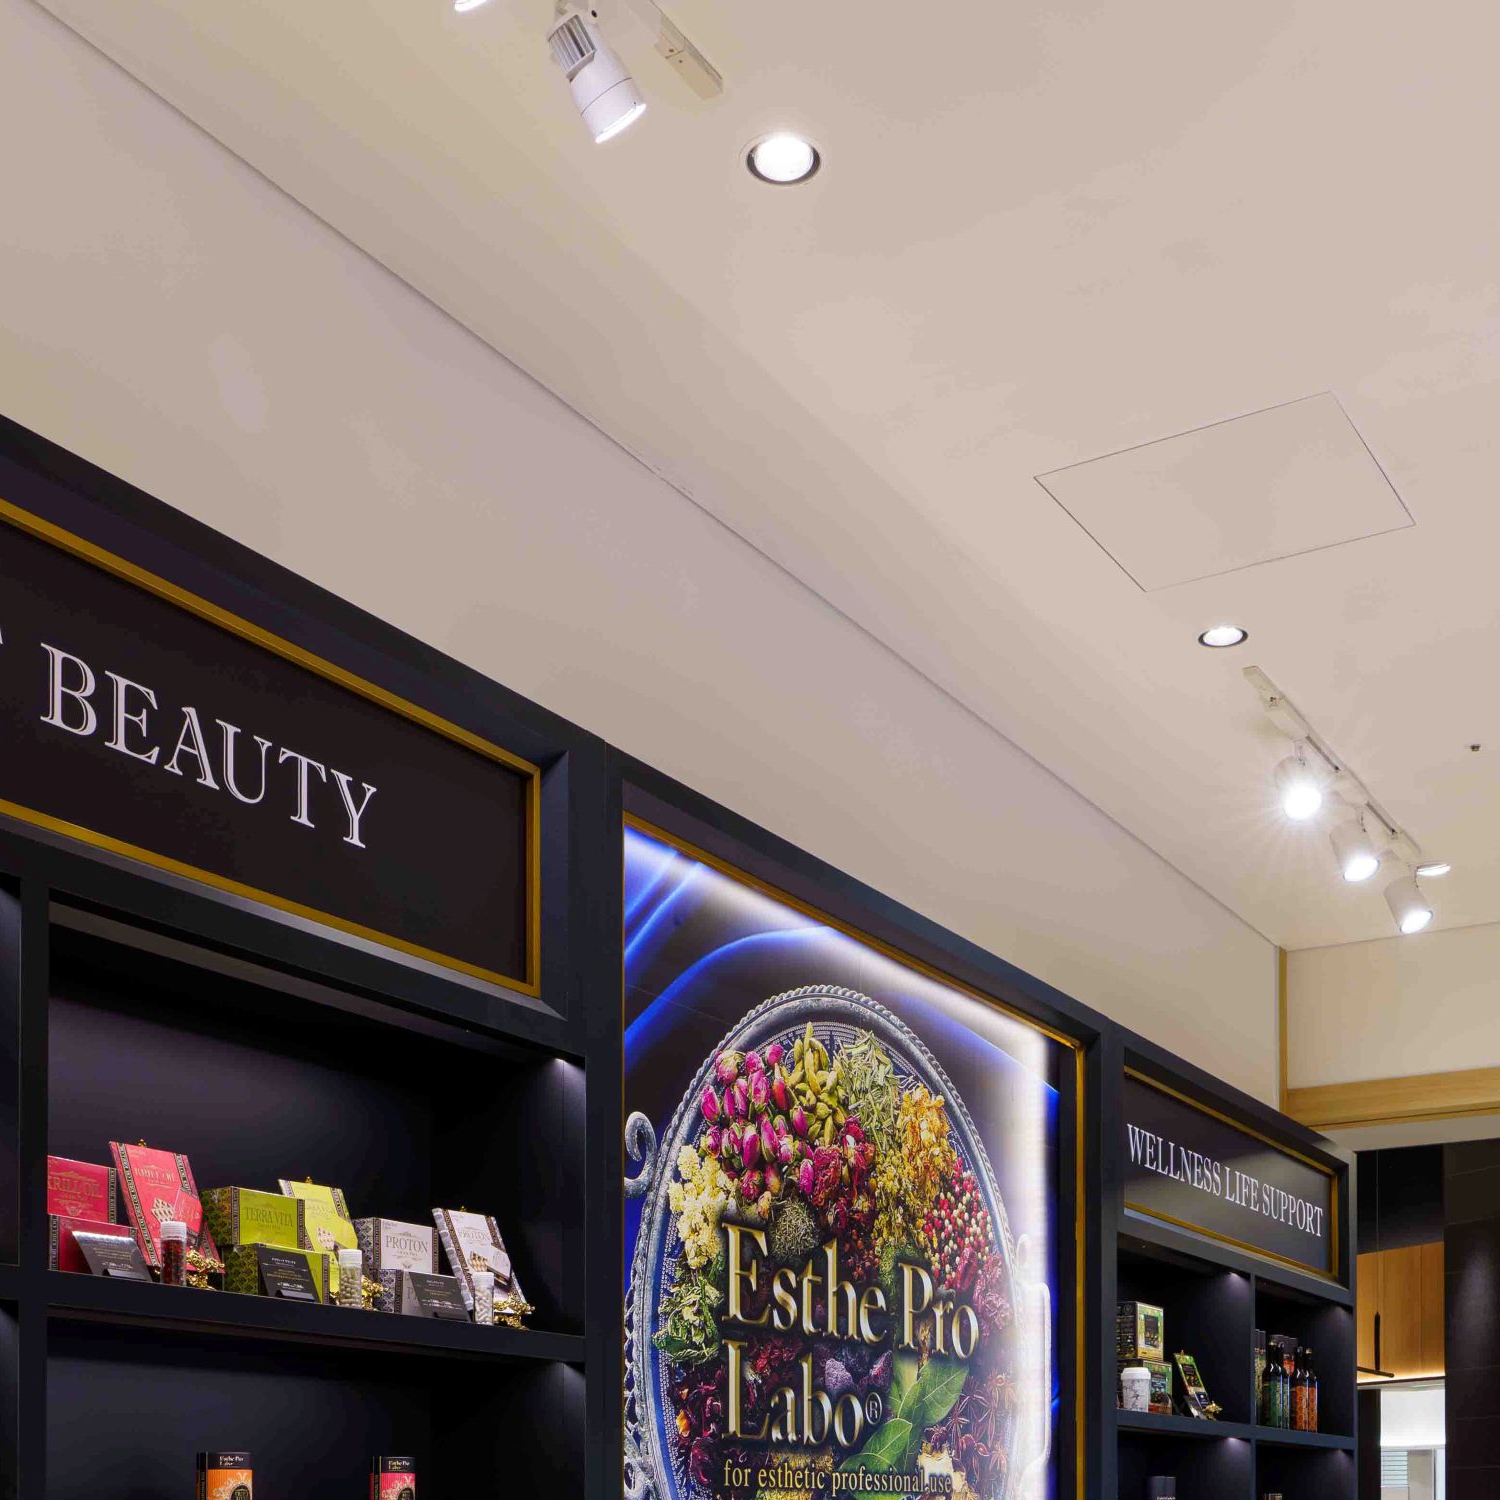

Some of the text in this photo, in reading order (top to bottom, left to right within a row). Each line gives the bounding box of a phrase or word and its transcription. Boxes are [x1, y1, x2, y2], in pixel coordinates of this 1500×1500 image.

[39, 642, 377, 850] BEAUTY
[244, 1206, 294, 1227] TERRA VITA
[1127, 1123, 1323, 1237] WELLNESS LIFE SUPPORT
[385, 1235, 428, 1253] PROTON
[722, 1222, 980, 1360] Esthe Pro
[724, 1459, 952, 1497] for esthetic professional use
